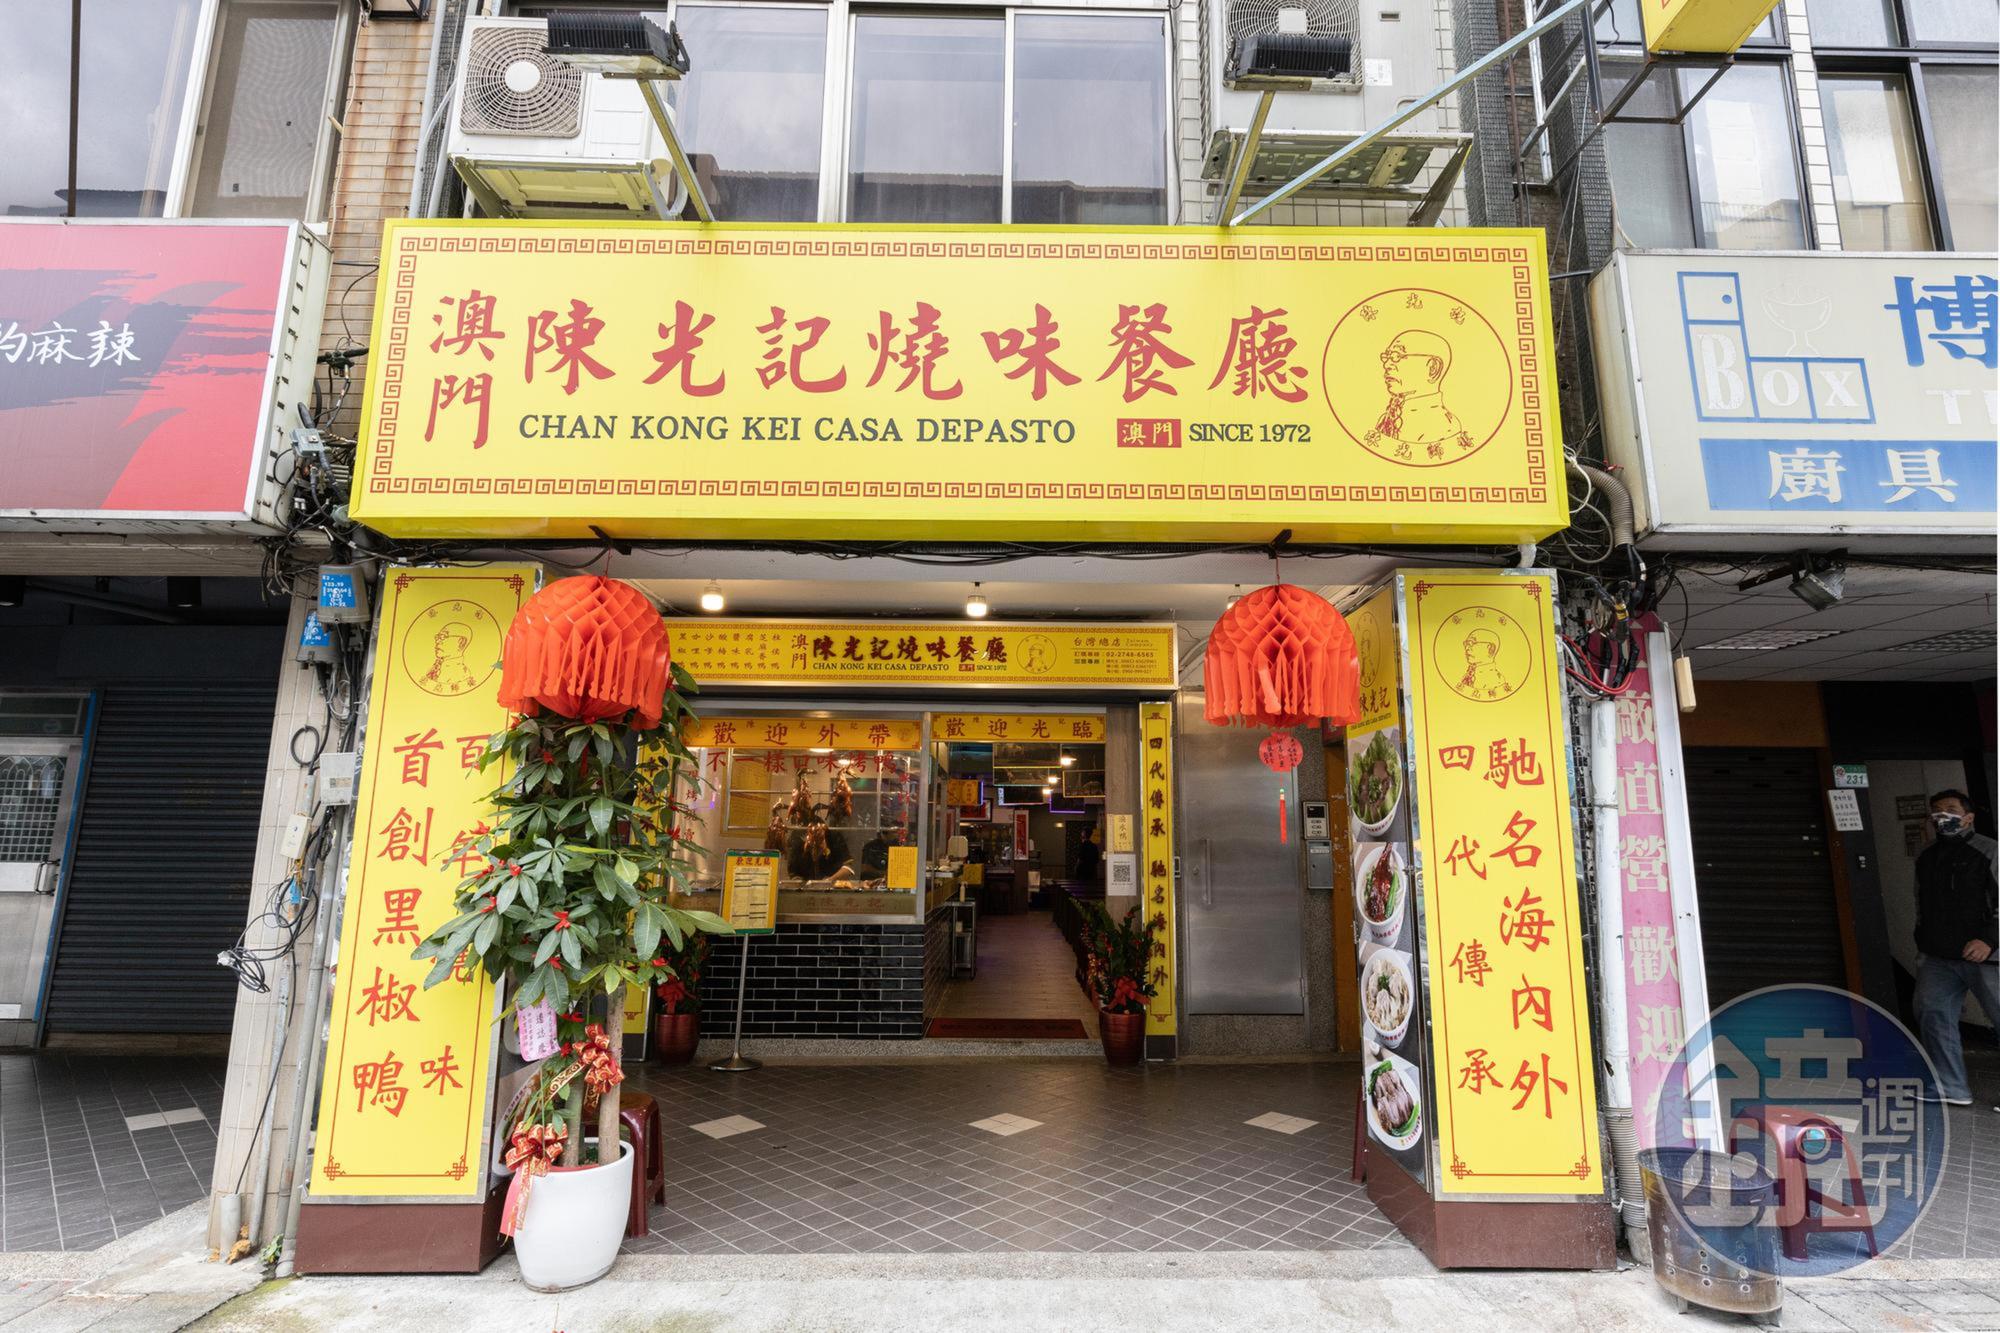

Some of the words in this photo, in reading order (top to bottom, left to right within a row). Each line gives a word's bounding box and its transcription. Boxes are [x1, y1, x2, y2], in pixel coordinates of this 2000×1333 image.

[524, 299, 1309, 404] 陳光記燒味餐廳
[424, 289, 506, 449] 澳門
[519, 414, 618, 439] CHAN
[630, 415, 729, 441] KONG
[741, 416, 802, 441] KEI
[814, 417, 903, 442] CASA
[916, 418, 1076, 444] DEPASTO
[1121, 420, 1177, 447] 澳門
[1188, 423, 1254, 442] SINCE
[1259, 423, 1311, 443] 1972
[1768, 447, 1958, 504] 廚具
[791, 633, 809, 670] 澳門
[812, 635, 1008, 663] 陳光記燒味餐廳
[812, 662, 838, 671] CHAN
[840, 662, 865, 671] KONG
[867, 662, 882, 671] KEI
[884, 662, 907, 671] CASA
[909, 663, 950, 672] DEPASTO
[713, 721, 892, 748] 歡迎外帶
[945, 717, 1094, 739] 歡迎光臨
[706, 750, 898, 774] 不一樣口味烤鴨
[1846, 774, 1864, 785] 231
[353, 727, 445, 1119] 首創黑椒鴨
[1438, 744, 1504, 1096] 四代傳承
[1484, 737, 1569, 1120] 馳名海內外
